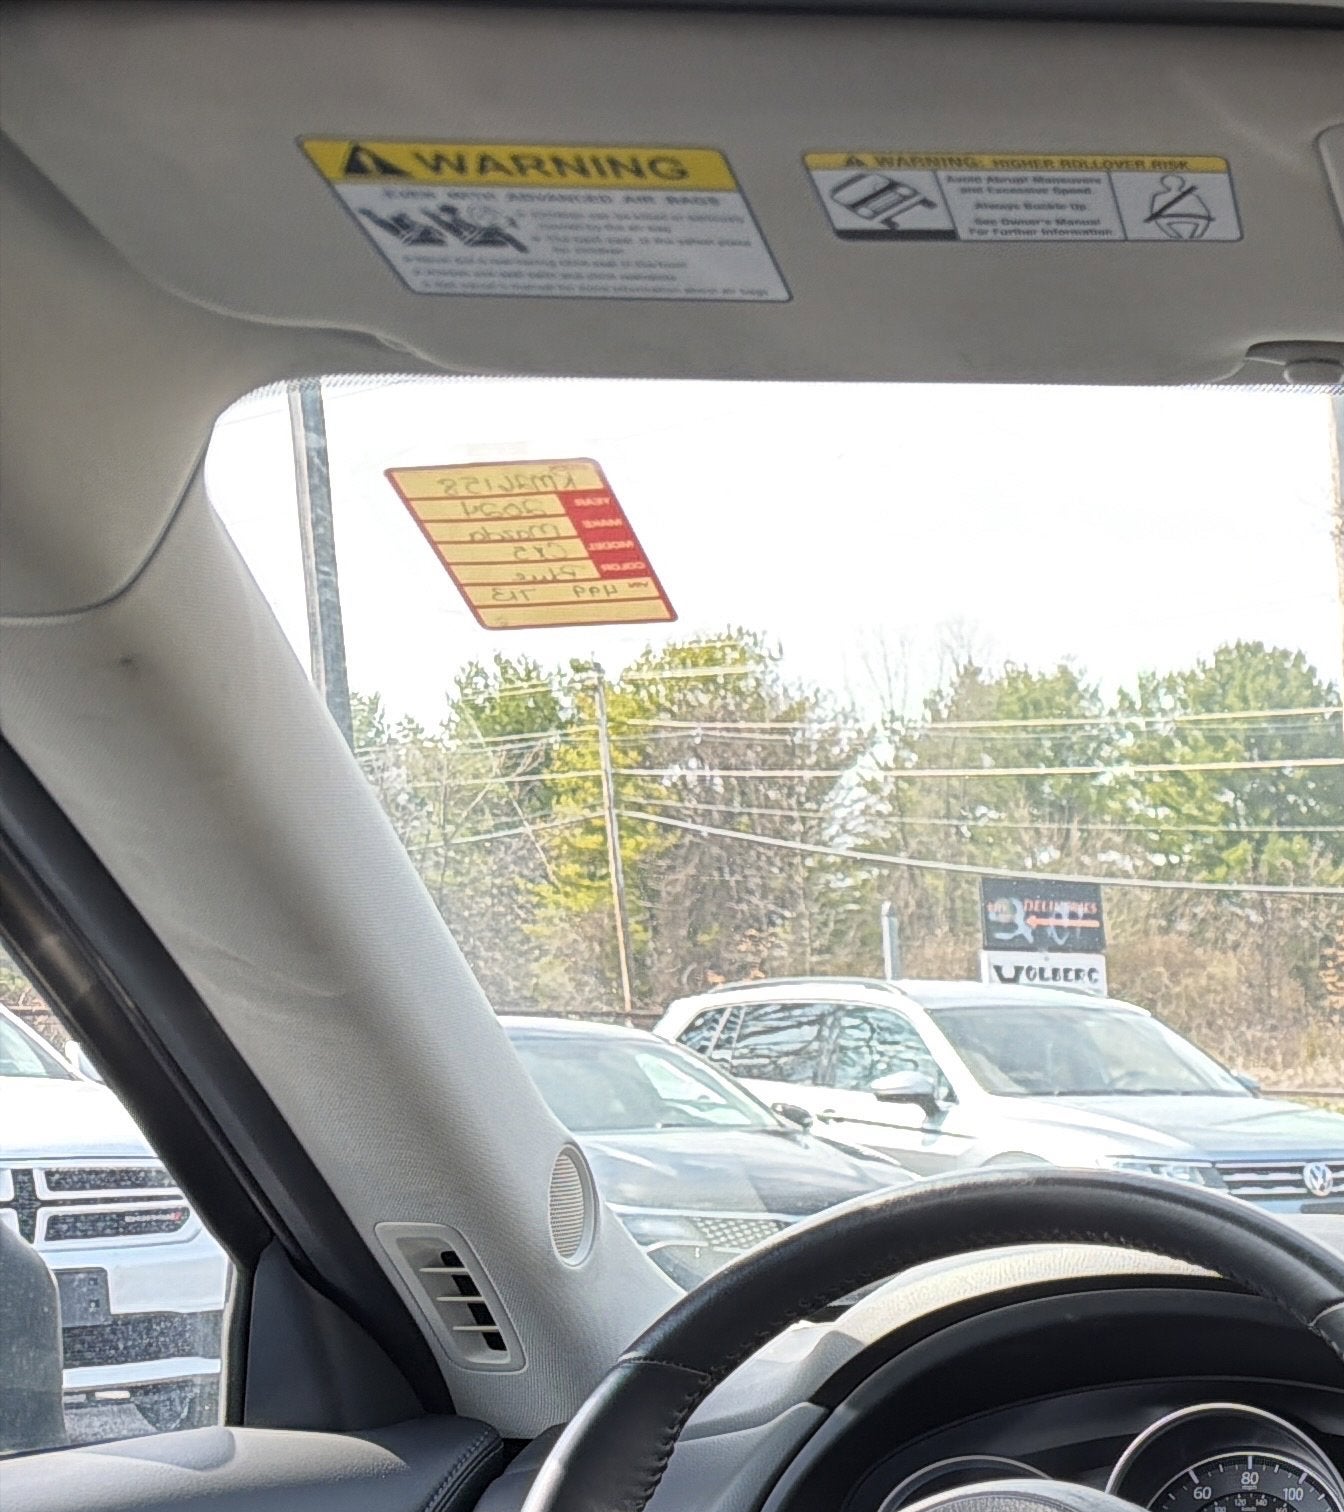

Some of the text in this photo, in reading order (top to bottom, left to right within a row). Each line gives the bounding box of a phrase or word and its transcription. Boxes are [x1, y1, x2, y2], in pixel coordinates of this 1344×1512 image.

[411, 149, 690, 182] WARNING
[1060, 159, 1146, 170] ROLLOVER
[1151, 160, 1190, 170] RISK
[1240, 1471, 1259, 1485] 80
[1193, 1486, 1212, 1499] 60
[1282, 1487, 1304, 1501] 100
[1234, 1499, 1247, 1507] 120
[1255, 1499, 1268, 1507] 140
